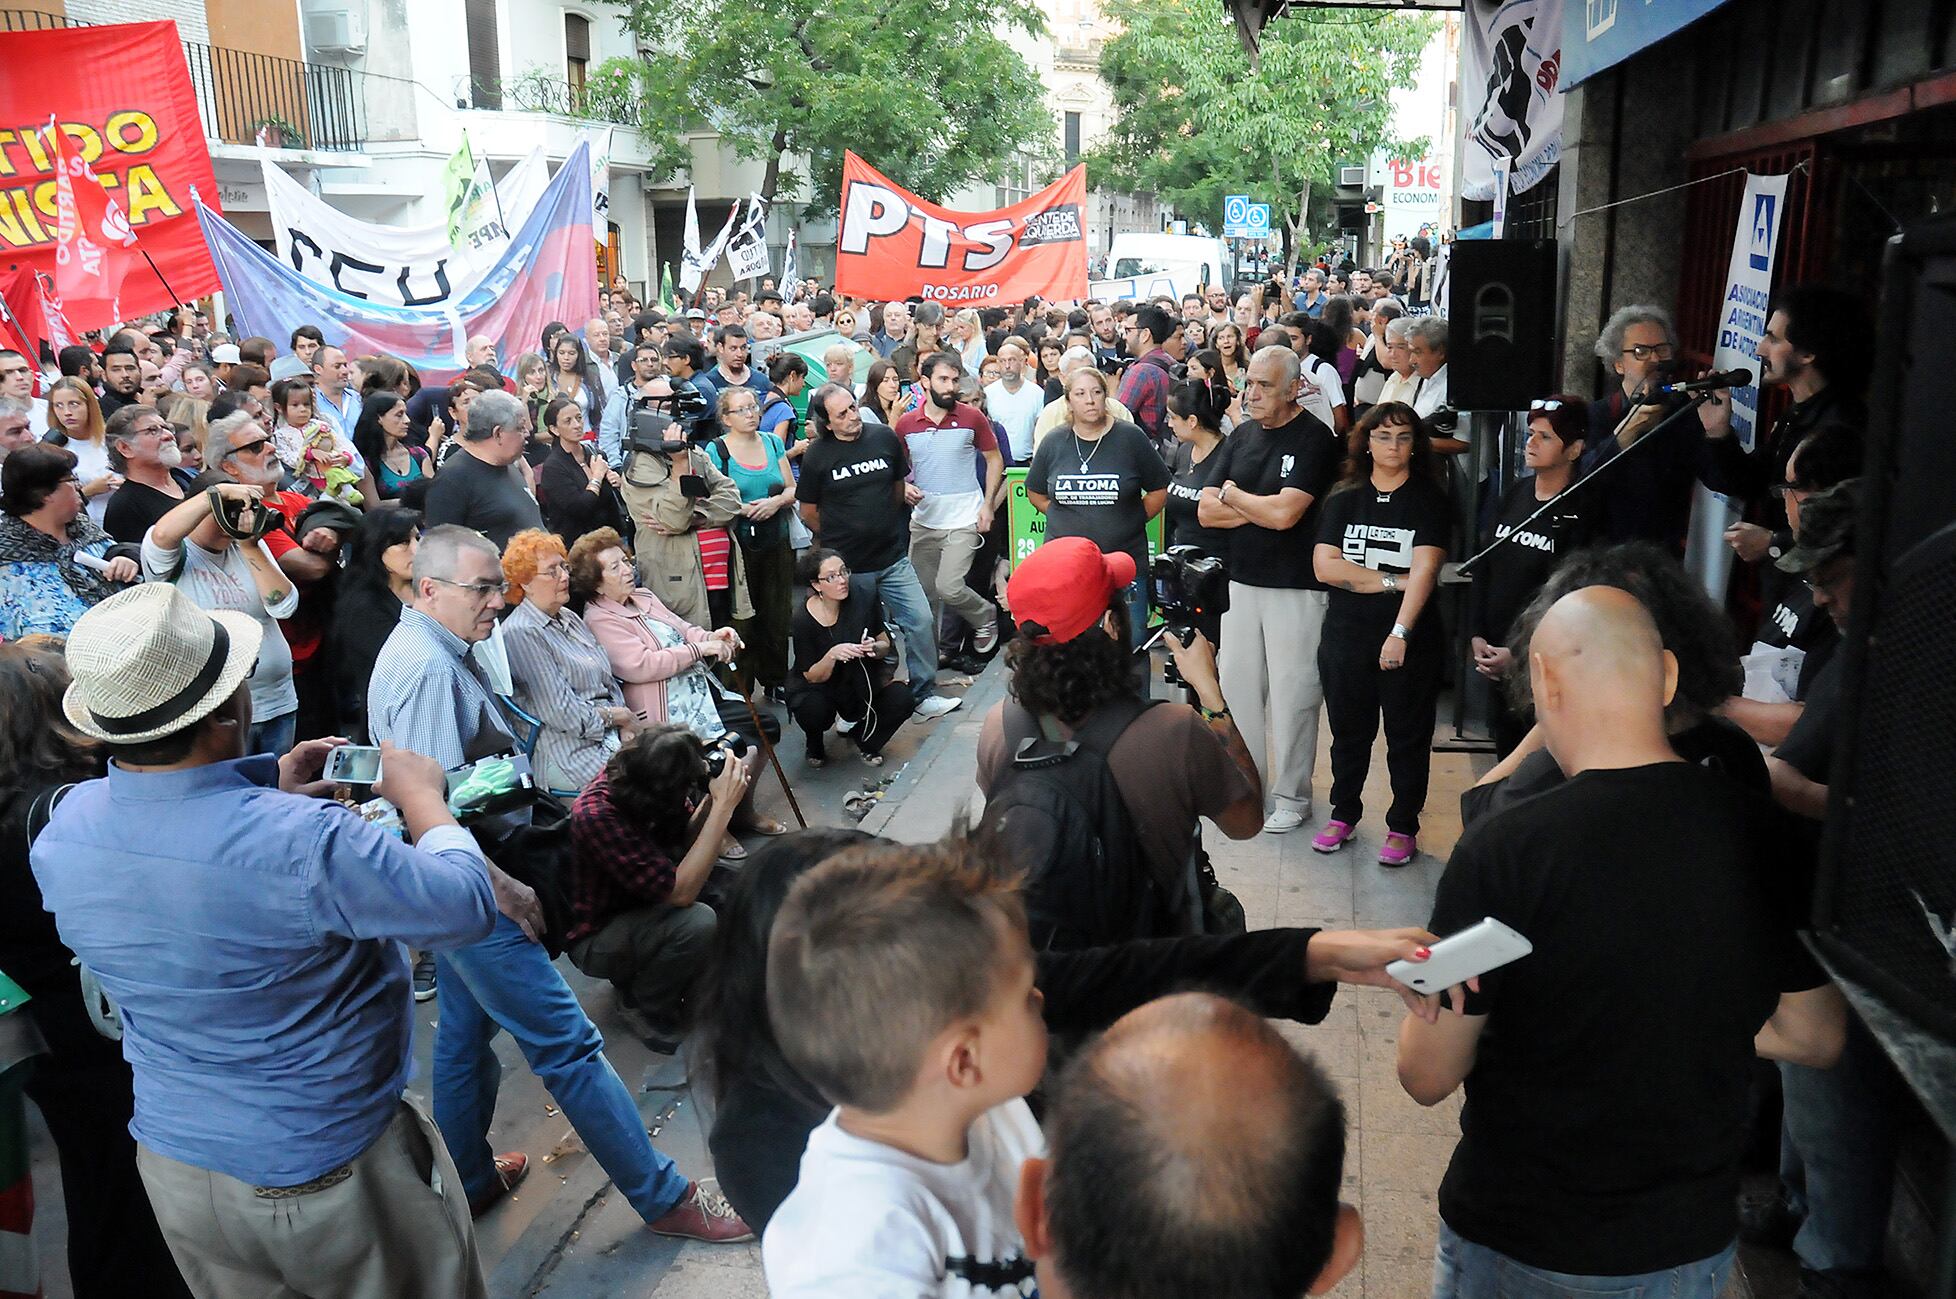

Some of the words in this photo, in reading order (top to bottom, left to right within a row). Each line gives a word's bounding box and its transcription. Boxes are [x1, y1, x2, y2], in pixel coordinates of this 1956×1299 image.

[1393, 192, 1439, 204] ECONOM
[840, 180, 1016, 272] PTS
[922, 284, 999, 301] ROSARIO
[831, 467, 852, 481] LA
[851, 458, 889, 475] TOMA
[1055, 480, 1073, 491] LA
[1077, 480, 1120, 491] TOMA
[1495, 523, 1512, 538] LA
[1511, 530, 1552, 551] TOMA
